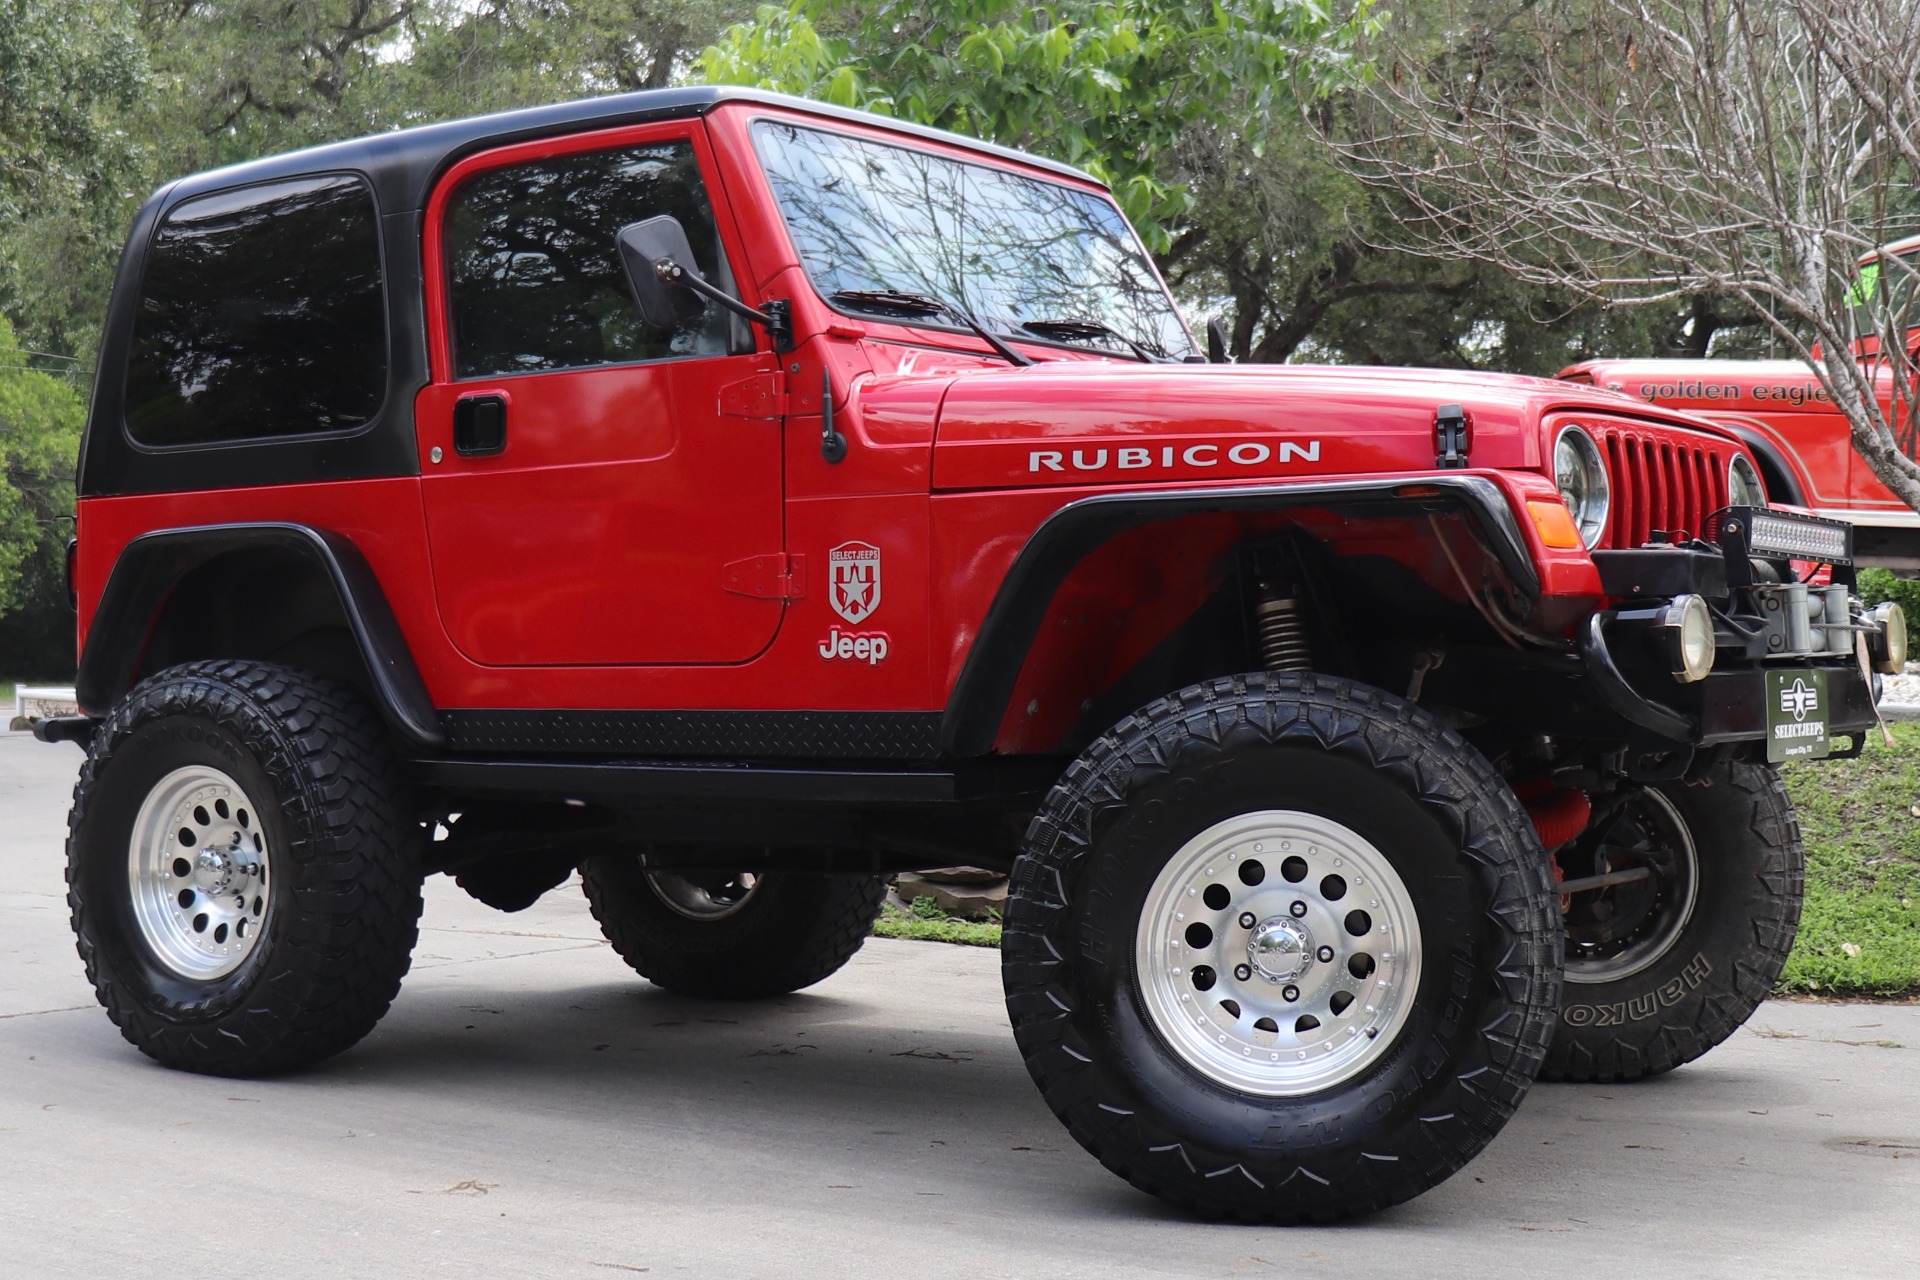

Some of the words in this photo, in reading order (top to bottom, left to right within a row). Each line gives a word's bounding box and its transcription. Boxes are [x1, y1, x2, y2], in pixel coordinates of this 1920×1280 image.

[1640, 379, 1740, 403] golden
[1751, 382, 1831, 406] eagle
[1028, 440, 1321, 472] RUBICON
[819, 629, 889, 665] Jeep
[1563, 951, 1713, 1027] Hanko
